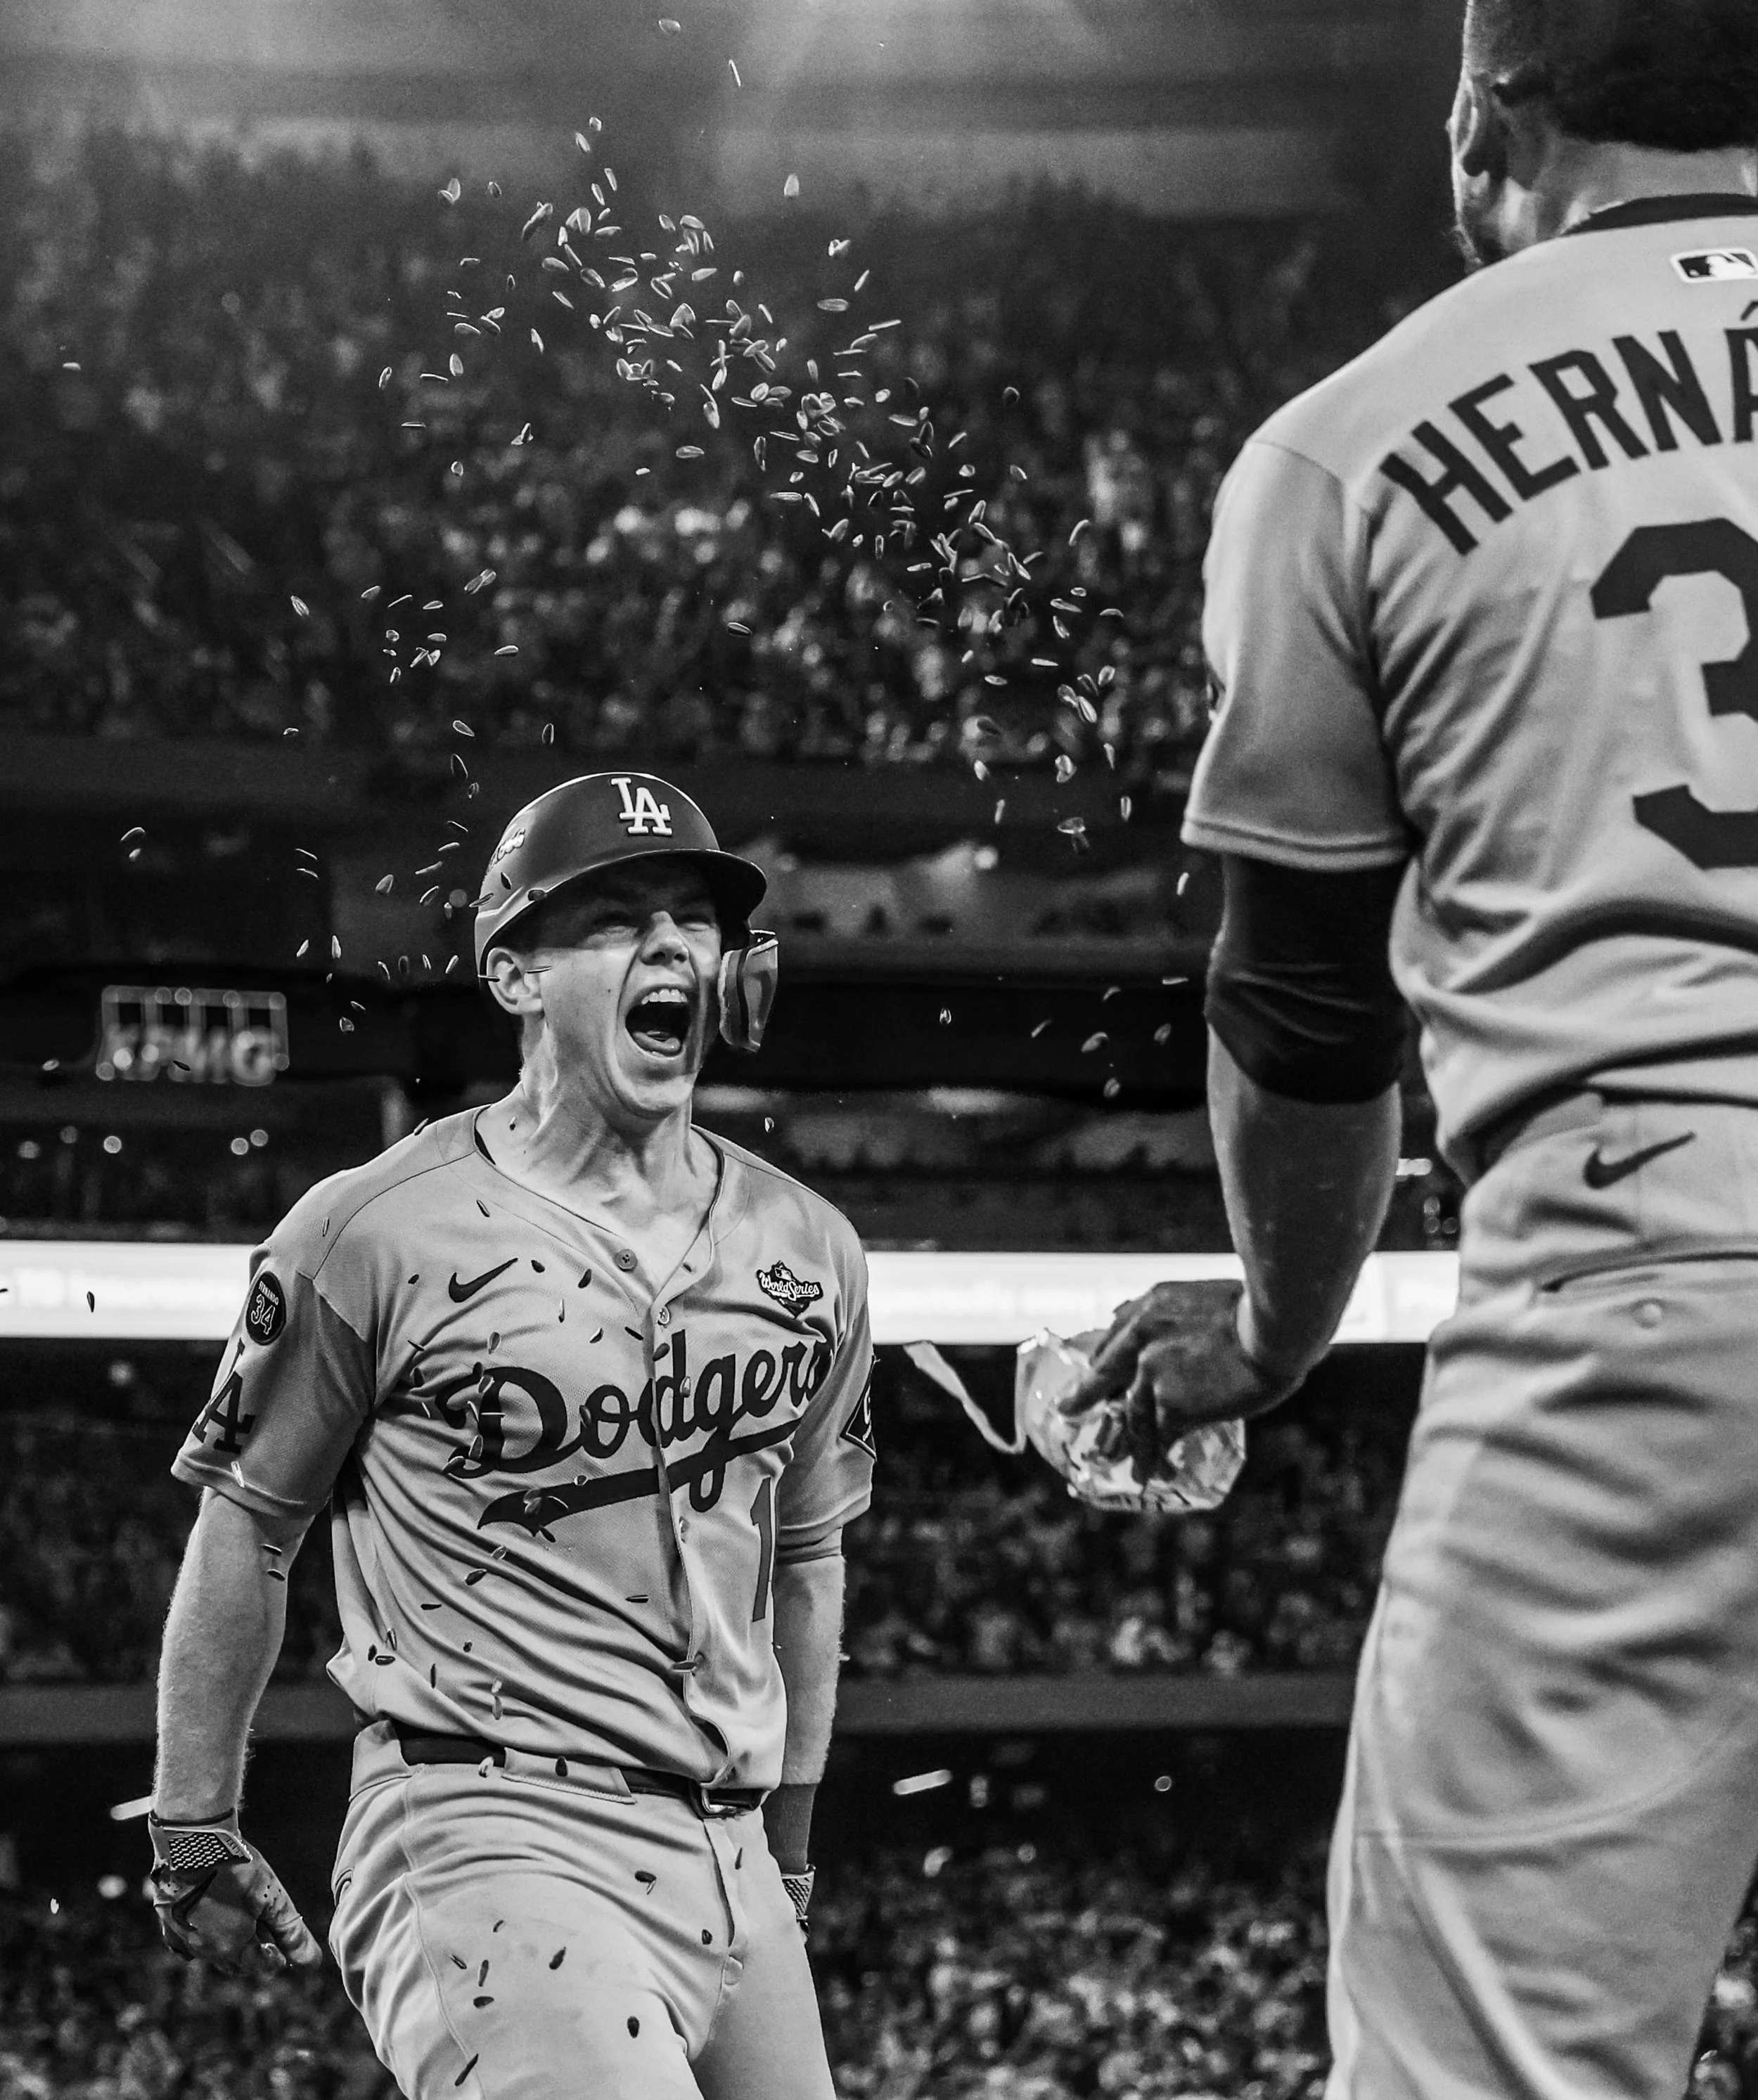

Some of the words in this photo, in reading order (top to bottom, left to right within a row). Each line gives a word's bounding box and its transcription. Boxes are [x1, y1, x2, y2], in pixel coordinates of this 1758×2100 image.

[1590, 517, 1758, 870] 3
[610, 777, 672, 835] LA
[250, 1294, 276, 1335] 34
[759, 1271, 789, 1294] World
[787, 1280, 820, 1301] Series
[435, 1329, 833, 1513] Dodgers
